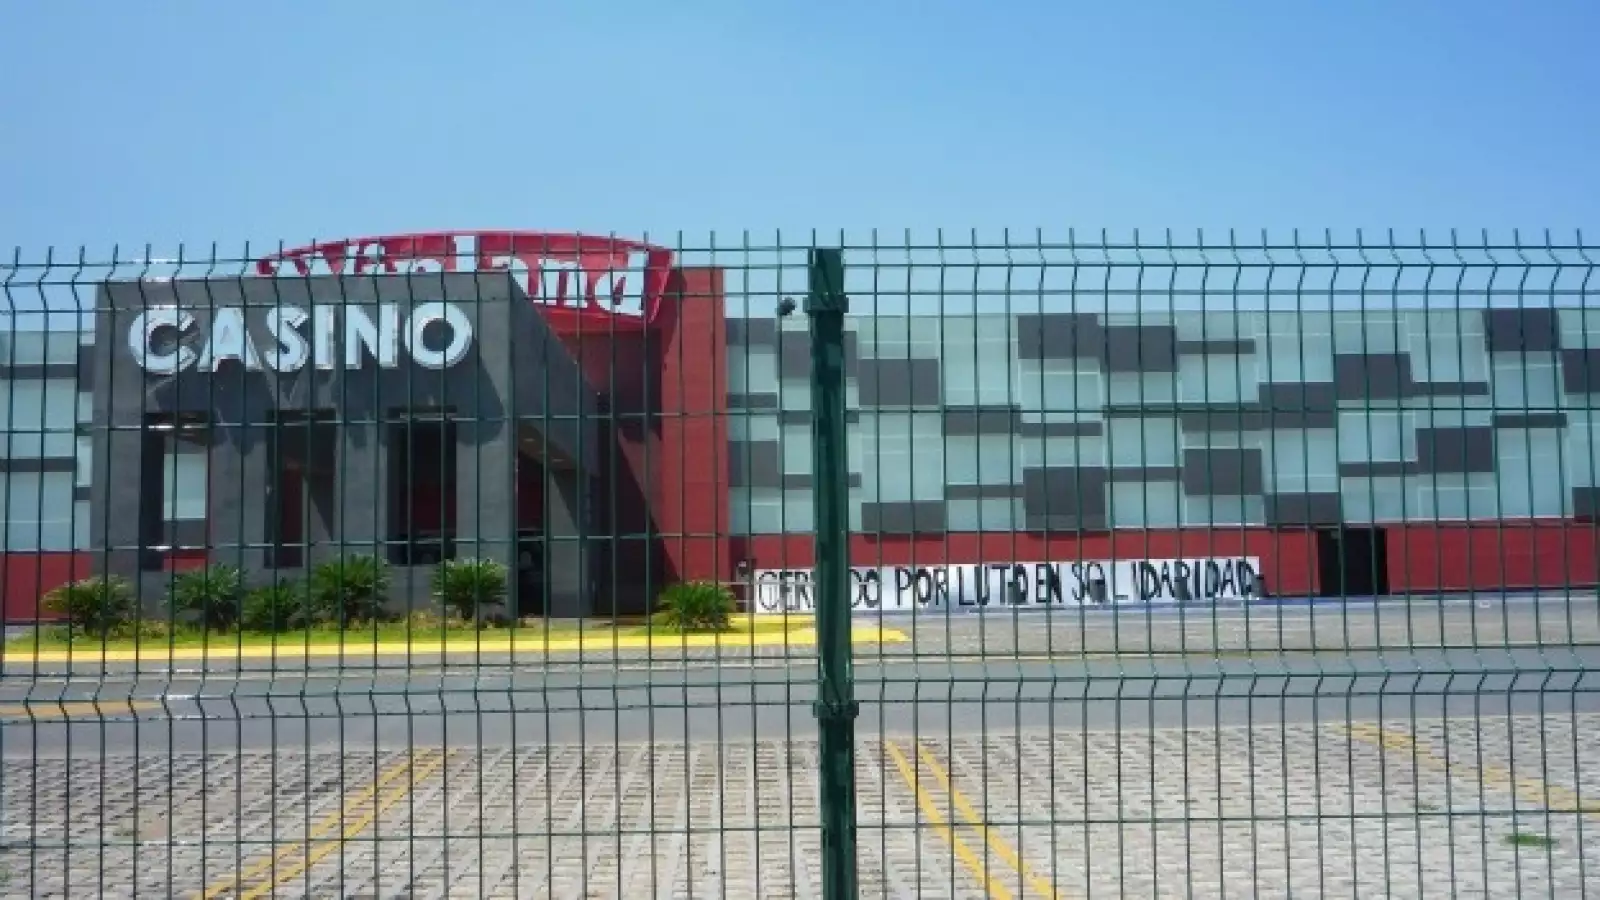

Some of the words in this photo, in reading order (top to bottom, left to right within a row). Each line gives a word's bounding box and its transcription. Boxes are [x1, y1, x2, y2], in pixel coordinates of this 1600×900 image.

[128, 301, 474, 374] CASINO
[758, 569, 881, 611] CERDO
[894, 566, 947, 606] POR
[1035, 562, 1063, 604] EN
